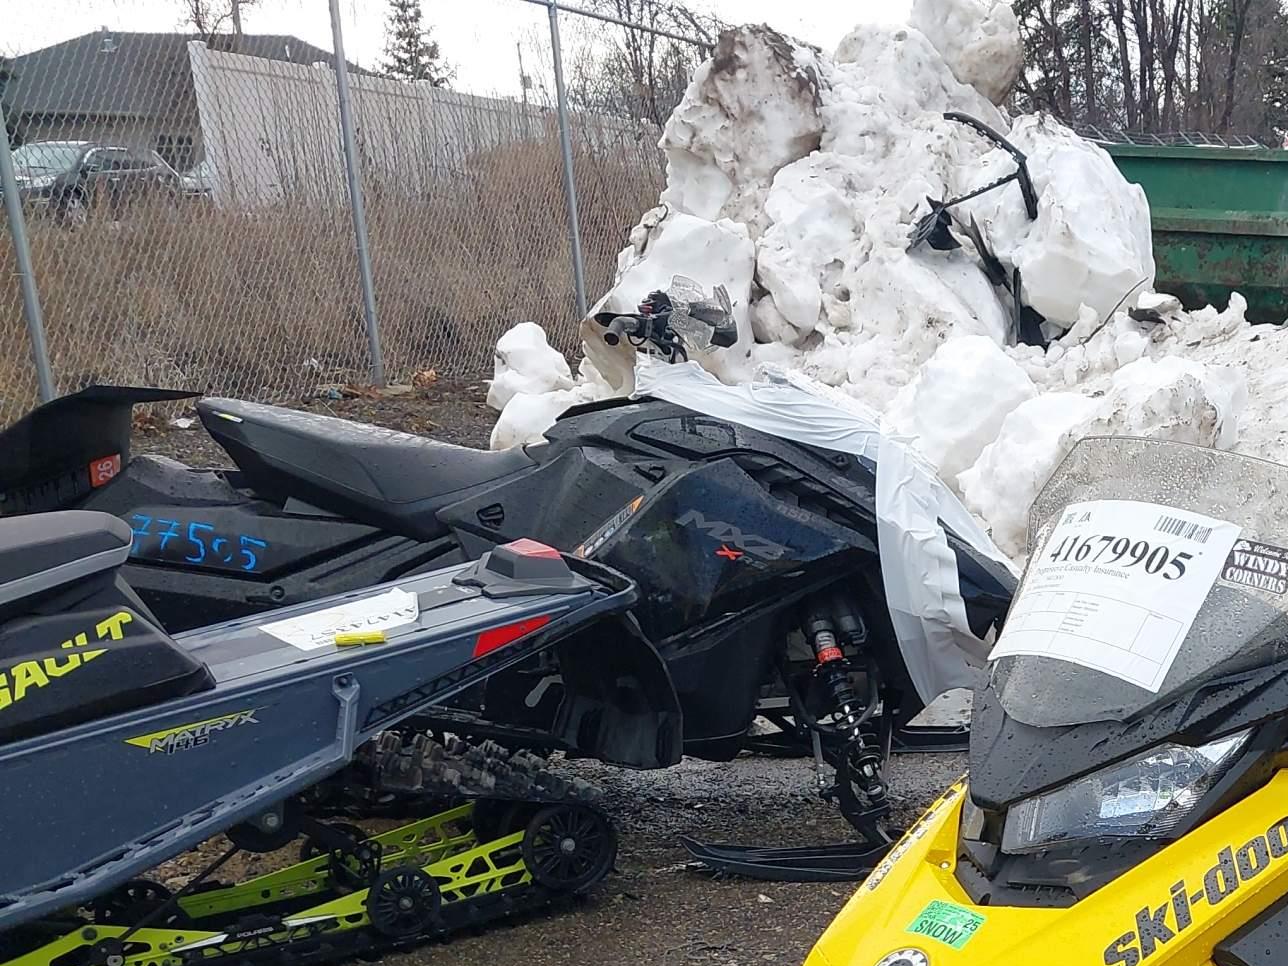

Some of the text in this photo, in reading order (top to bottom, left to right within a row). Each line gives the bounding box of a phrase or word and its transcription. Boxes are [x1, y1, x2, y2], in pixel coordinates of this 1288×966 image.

[98, 459, 114, 481] 26
[1050, 534, 1194, 580] 41679905
[1225, 567, 1286, 594] CORNERS
[150, 710, 260, 754] MATRYX
[914, 919, 963, 945] SNOW
[963, 918, 981, 932] 25
